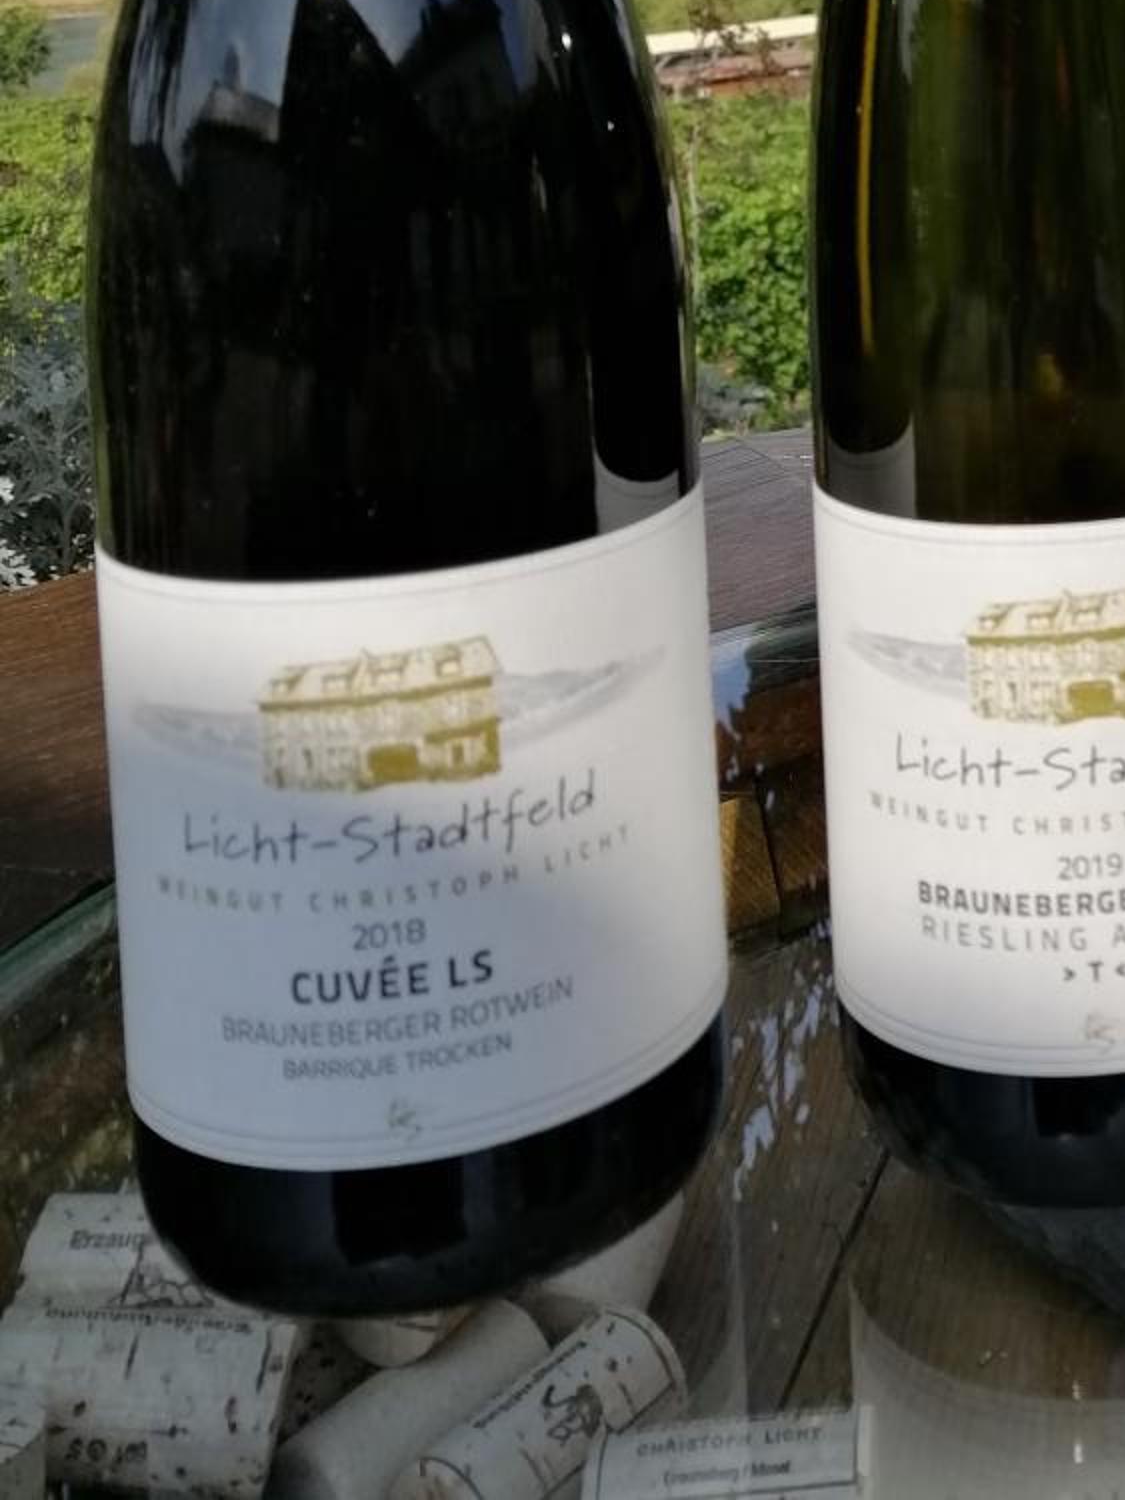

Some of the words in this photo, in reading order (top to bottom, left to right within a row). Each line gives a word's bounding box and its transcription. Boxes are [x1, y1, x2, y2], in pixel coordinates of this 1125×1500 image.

[184, 768, 595, 865] Licht-Stadtfeld
[870, 789, 989, 834] WEINGUT
[157, 873, 283, 914] WEINGUT
[308, 863, 520, 914] CHRISTOPH
[543, 823, 632, 874] LICHT
[1056, 853, 1125, 882] 2019
[351, 918, 427, 952] 2018
[921, 914, 1088, 953] RIESLING
[290, 953, 429, 1005] CUVÉE
[447, 949, 495, 989] LS
[221, 1011, 442, 1048] BRAUNEBERGER
[449, 975, 575, 1029] ROTWEIN
[282, 1046, 398, 1080] BARRIQUE
[405, 1033, 514, 1076] TROCKEN
